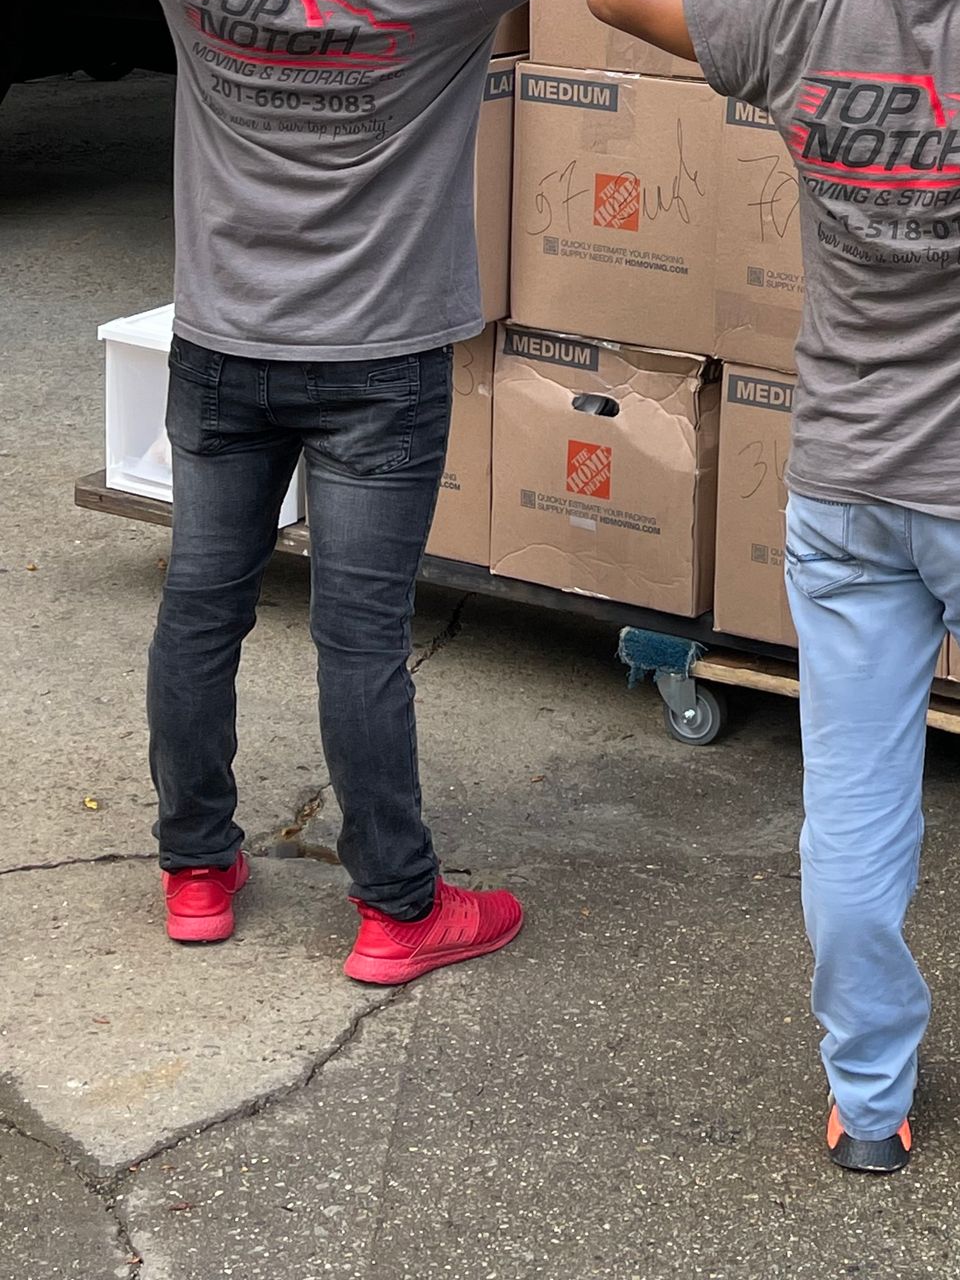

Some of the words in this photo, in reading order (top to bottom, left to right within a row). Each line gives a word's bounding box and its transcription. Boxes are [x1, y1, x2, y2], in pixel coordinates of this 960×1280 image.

[185, 2, 361, 55] NOTCH
[192, 42, 256, 77] MOVING
[259, 66, 274, 80] &
[277, 68, 374, 86] STORAGE
[211, 74, 377, 113] 201-660-3083
[528, 79, 610, 106] MEDIUM
[801, 76, 921, 127] TOP
[874, 190, 902, 206] &
[922, 246, 949, 268] top
[512, 335, 591, 365] MEDIUM
[737, 381, 791, 407] MEDI
[567, 445, 611, 493] HOME
[570, 448, 590, 467] THE
